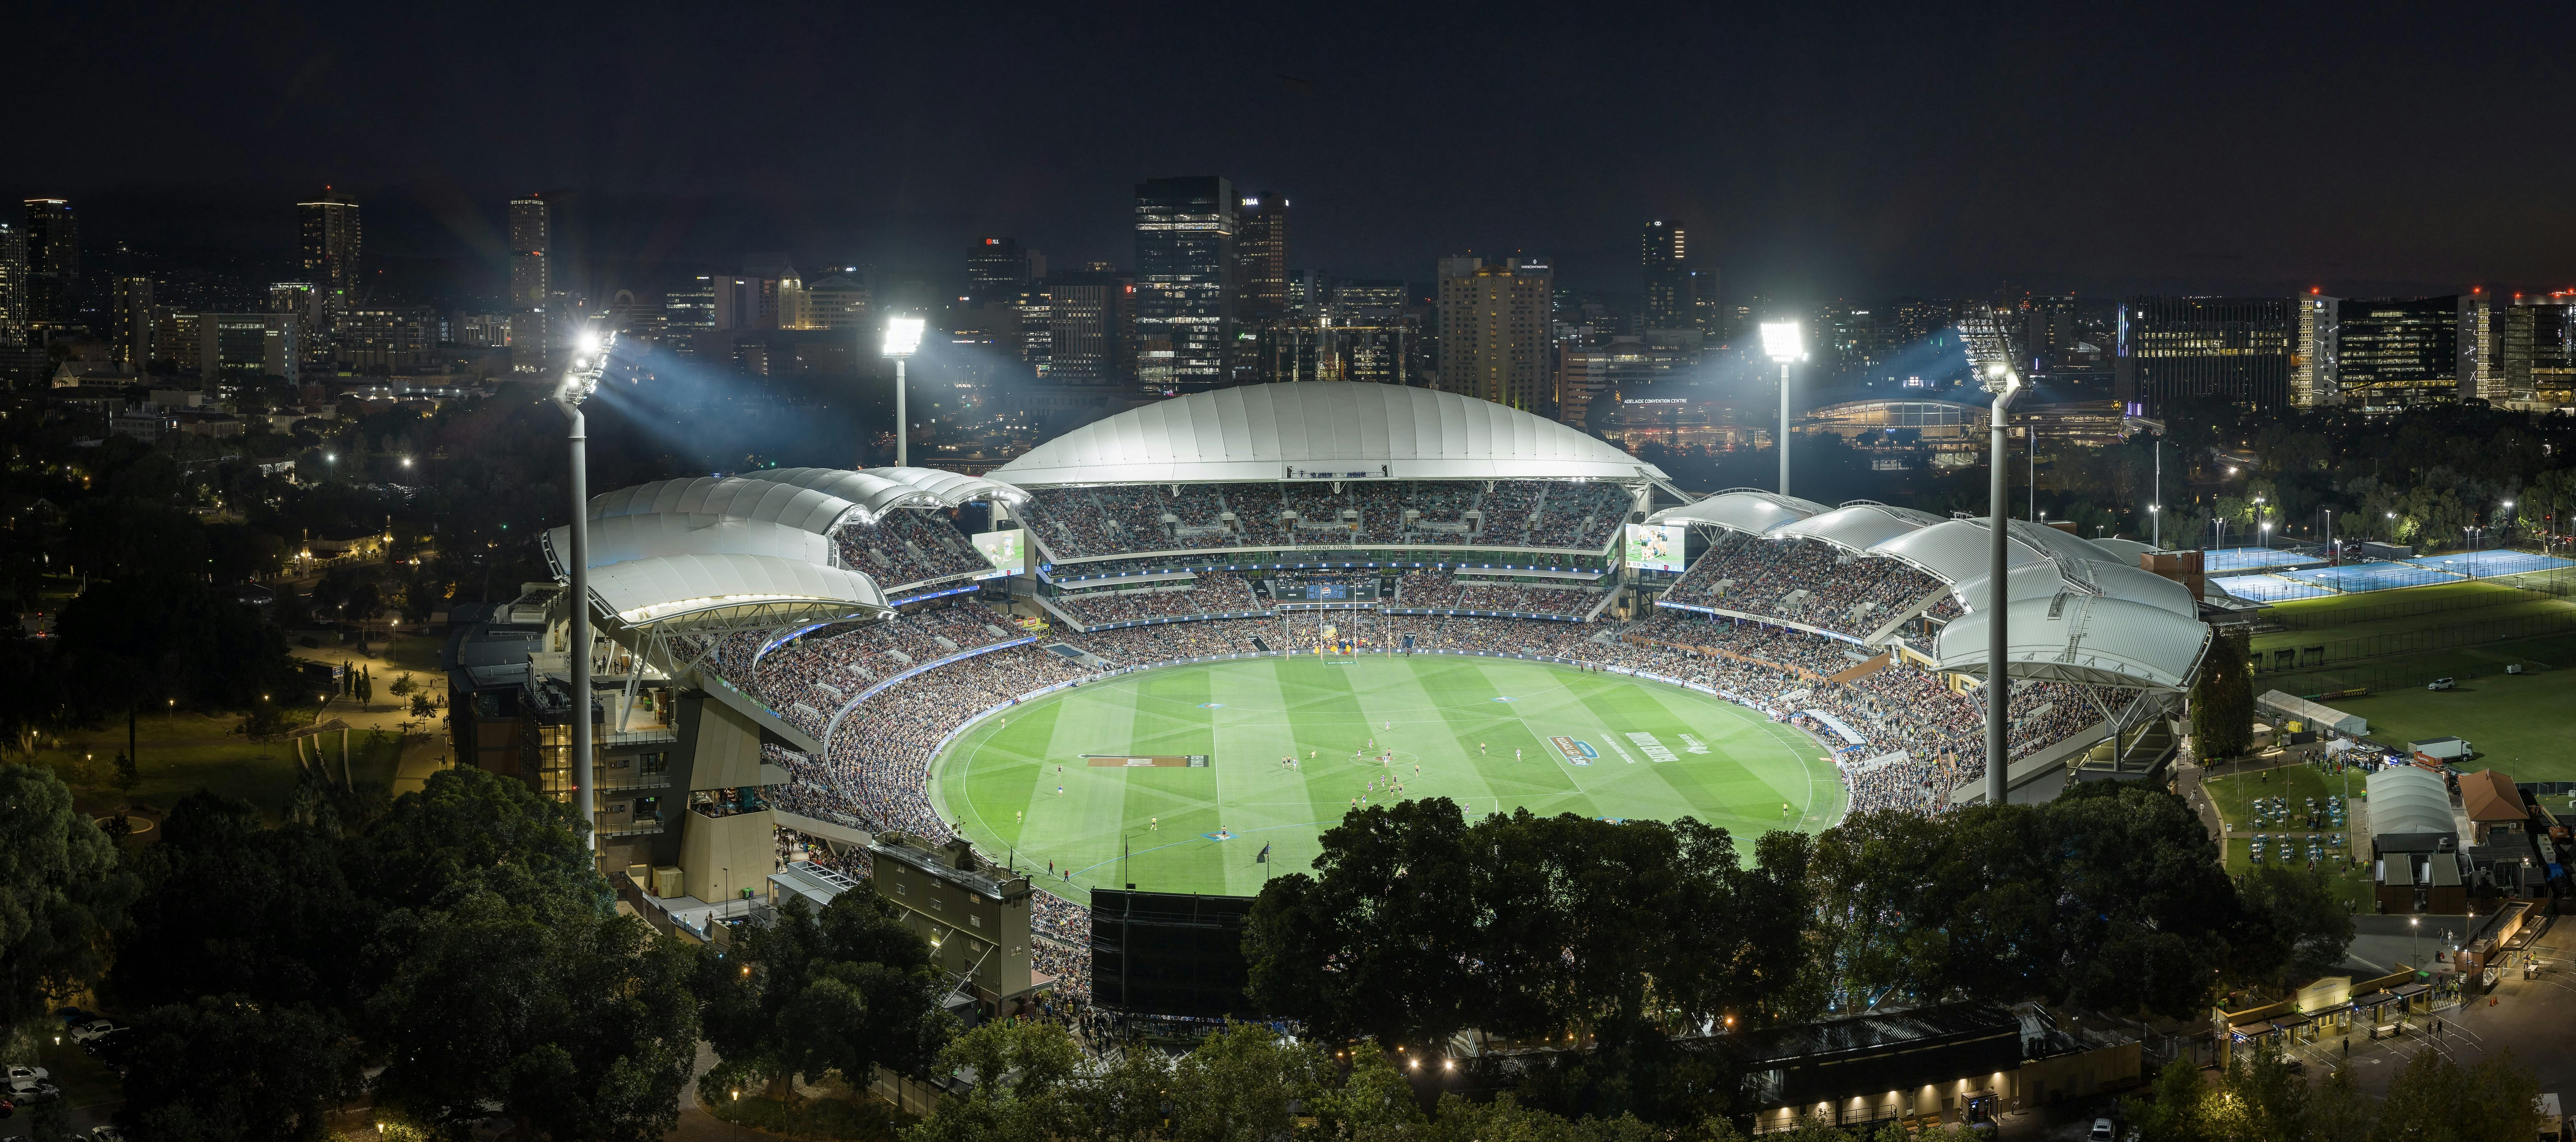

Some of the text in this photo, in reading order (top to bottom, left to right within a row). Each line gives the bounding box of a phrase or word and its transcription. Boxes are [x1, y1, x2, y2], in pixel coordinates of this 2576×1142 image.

[1745, 614, 1771, 623] CHAPPELL
[1556, 737, 1574, 750] TOYOTA
[1625, 732, 1680, 762] GATHER ROUND
